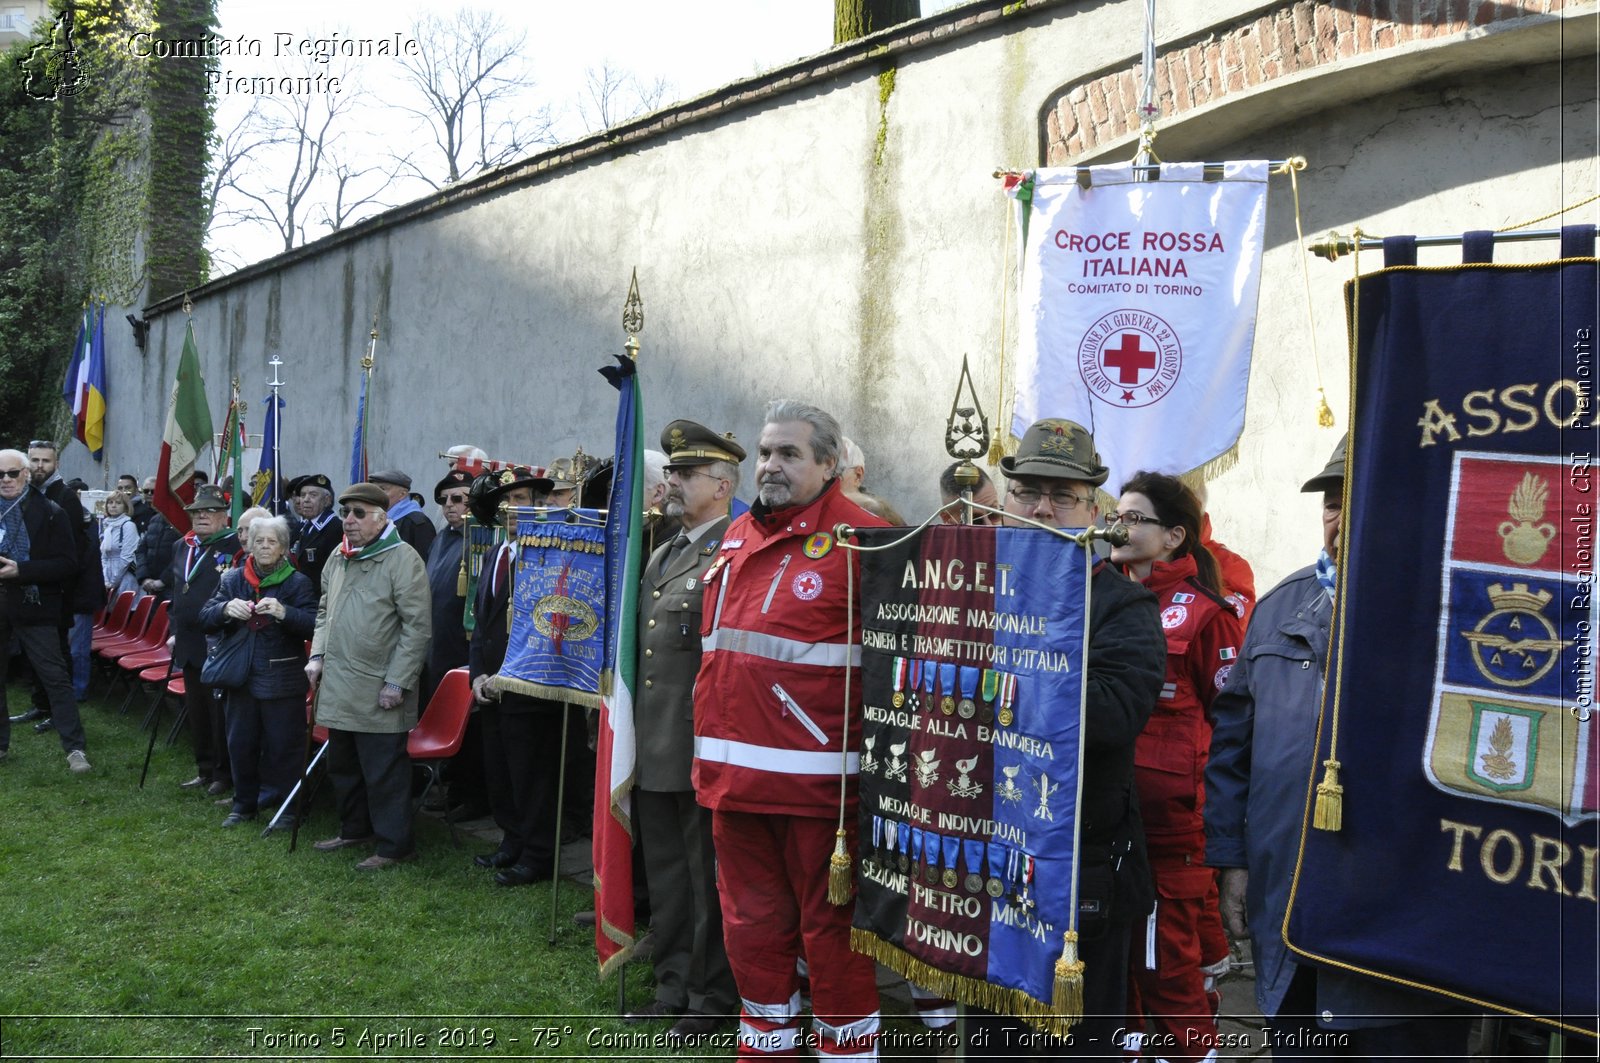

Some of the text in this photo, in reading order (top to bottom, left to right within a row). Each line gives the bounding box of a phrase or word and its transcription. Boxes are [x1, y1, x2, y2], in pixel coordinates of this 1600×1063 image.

[1055, 229, 1225, 254] CROCE ROSSA
[1083, 257, 1188, 278] ITALIANA
[1067, 282, 1203, 297] COMITATO DI TORINO
[1081, 313, 1178, 399] CONVENZIONE DI GINEVRA 22 AGOSTO 1864
[1417, 378, 1600, 448] ASSO
[902, 558, 1016, 597] A.N.G.E.T.
[877, 602, 1048, 636] ASSOCIAZIONE NAZIONALE
[862, 629, 1070, 673] GENIERI E TRASMETTITORI D'ITALIA
[863, 704, 1055, 761] MEDAGLIE ALLA BANDIERA
[878, 794, 1026, 848] MEDAGLIE INDIVIDUALI
[862, 858, 909, 896] SEZIONE
[905, 914, 983, 957] TORINO
